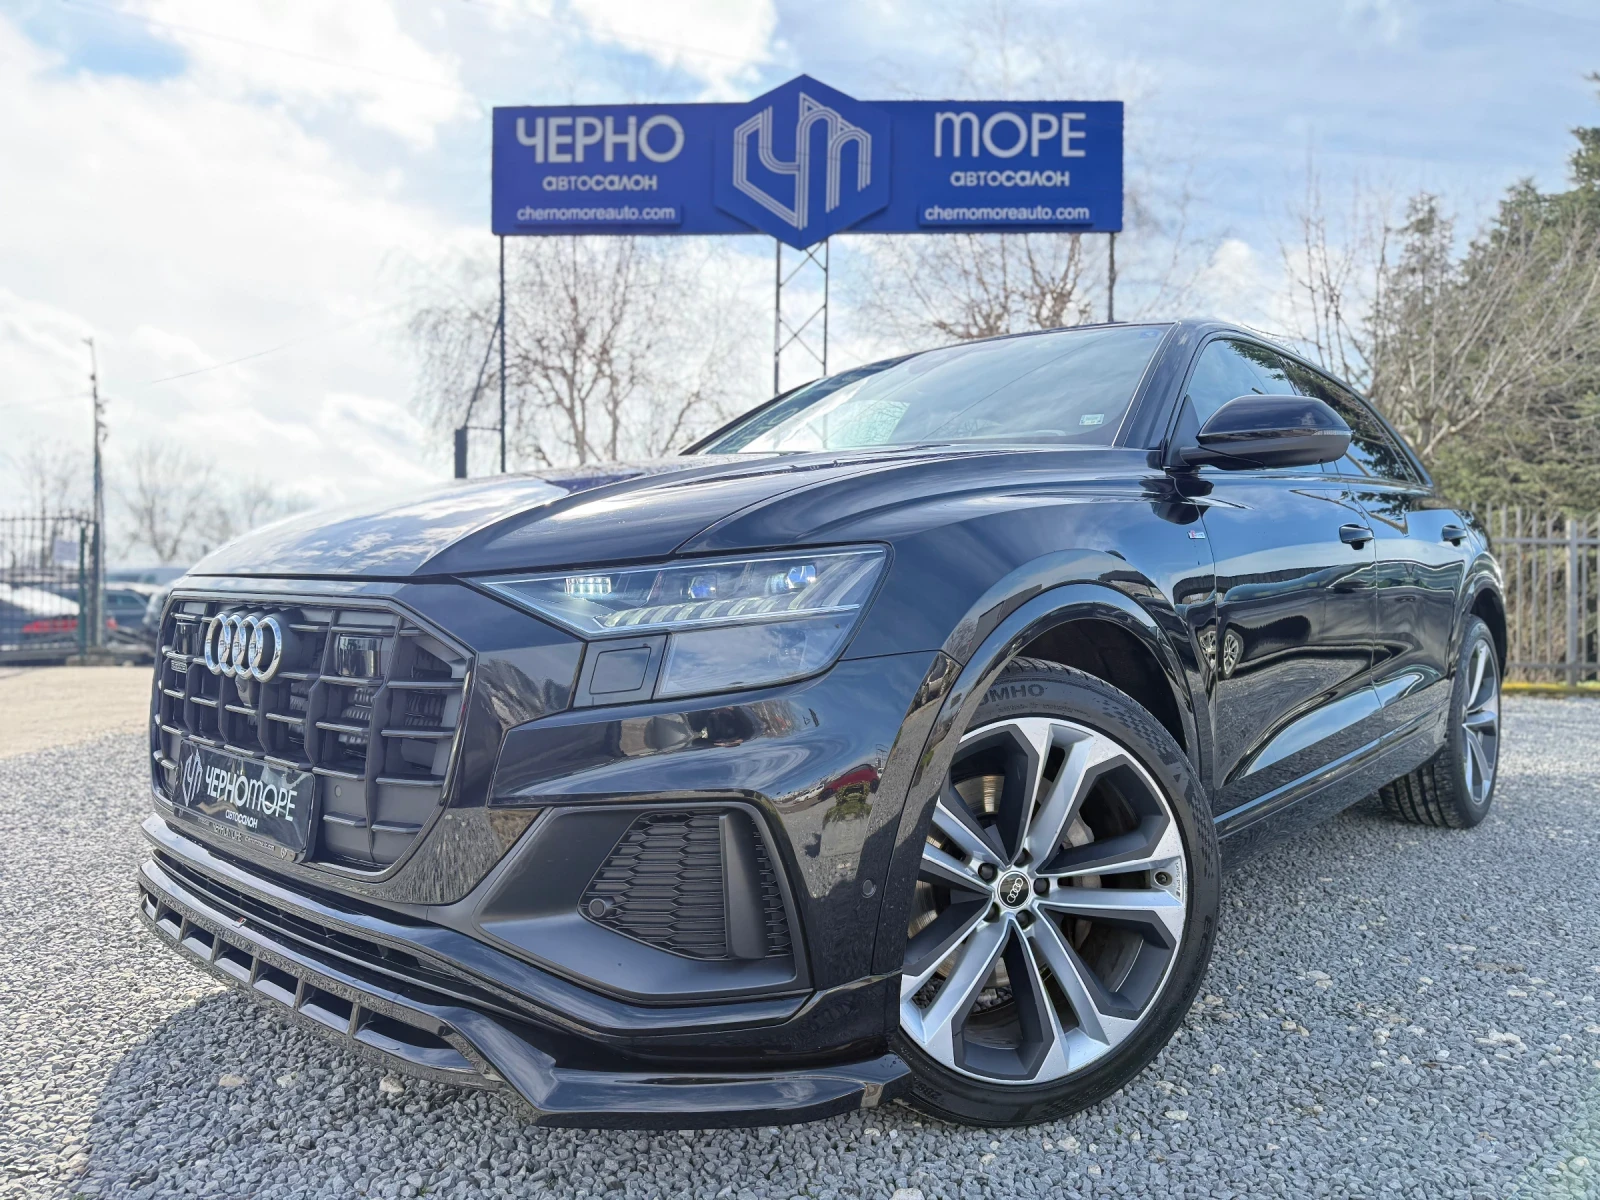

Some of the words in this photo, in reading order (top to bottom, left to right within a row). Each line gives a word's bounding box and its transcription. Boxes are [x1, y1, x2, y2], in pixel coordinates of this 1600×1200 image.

[516, 114, 685, 163] ЧЕРНО
[934, 111, 1087, 157] МОРЕ
[516, 205, 675, 221] chernomoreauto.com
[924, 205, 1090, 221] chernomoreauto.com
[205, 765, 298, 821] ЧЕРНОМОРЕ
